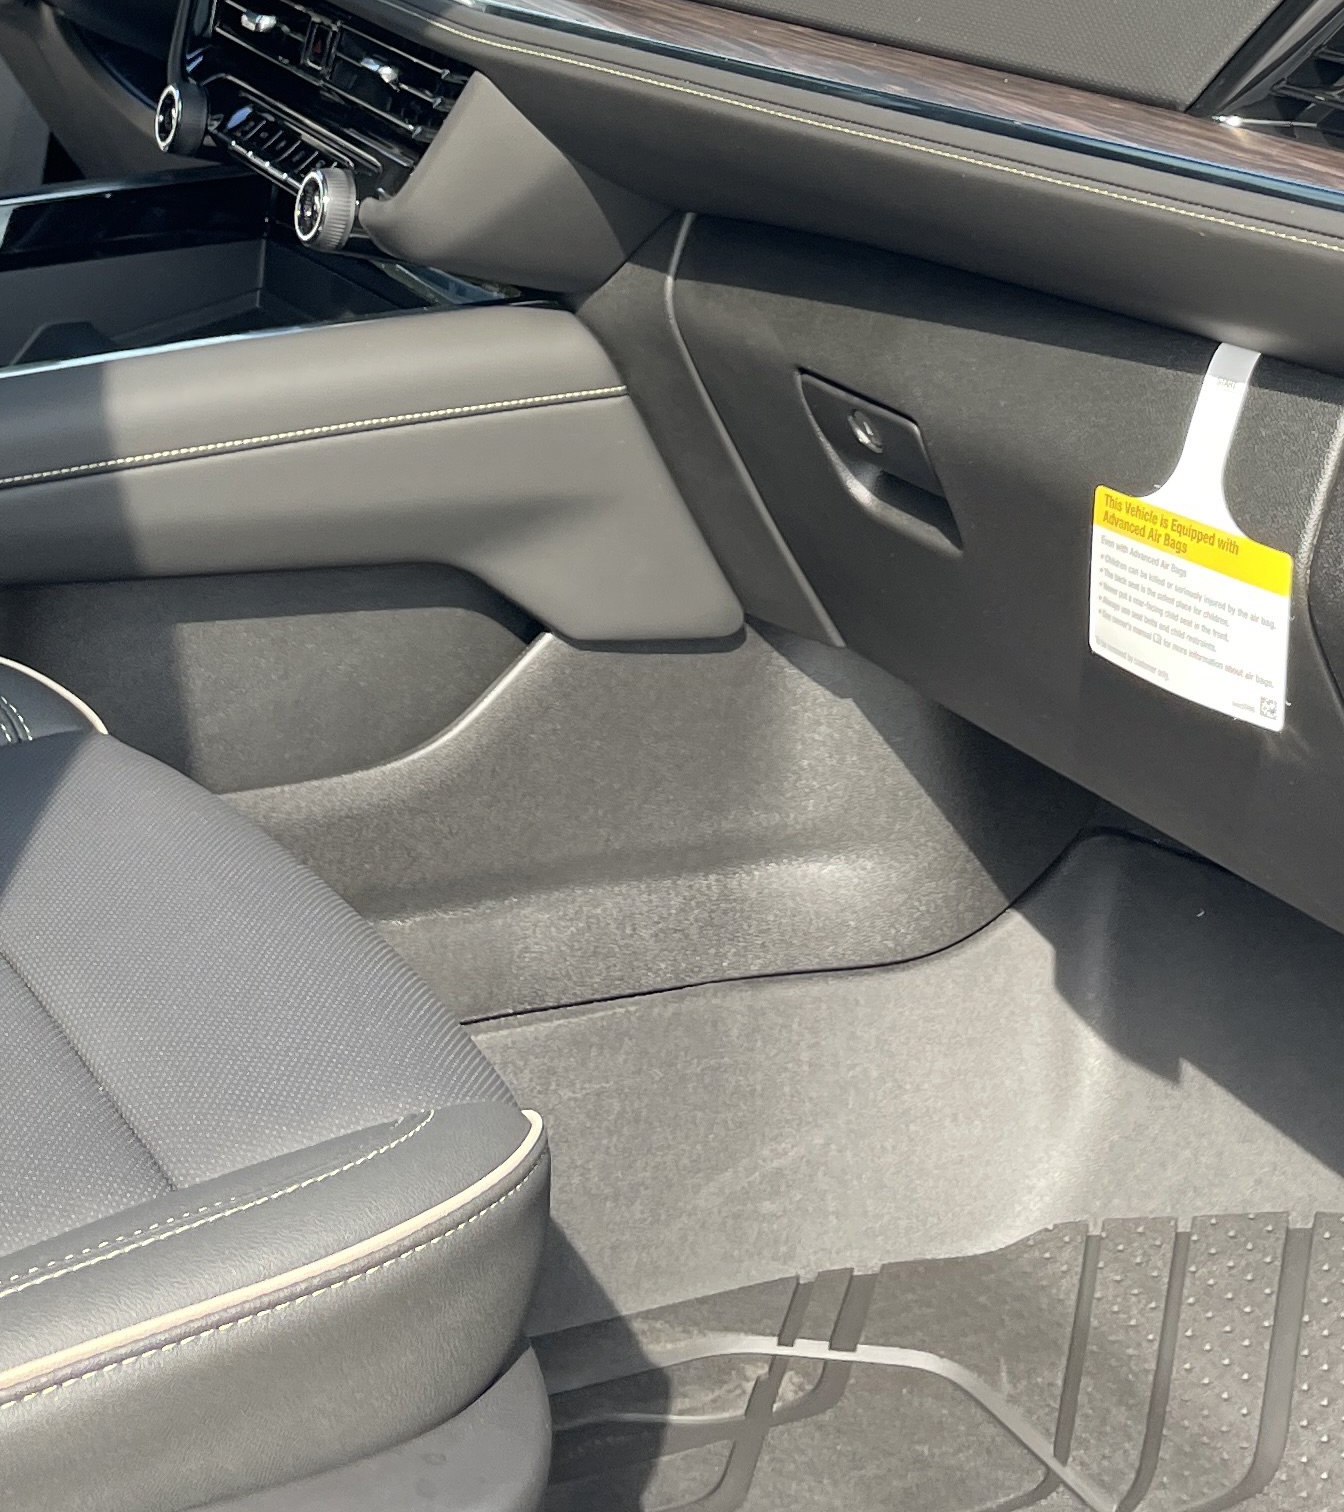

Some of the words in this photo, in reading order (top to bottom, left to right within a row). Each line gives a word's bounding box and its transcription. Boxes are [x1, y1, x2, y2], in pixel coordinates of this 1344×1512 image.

[1102, 509, 1145, 538] Advanced
[1147, 526, 1160, 544] Air
[1163, 532, 1187, 556] Bags
[1105, 492, 1122, 513] This
[1125, 500, 1158, 526] Vehicle
[1160, 514, 1168, 530] is
[1170, 518, 1215, 549] Equipped
[1217, 535, 1239, 556] with
[1100, 534, 1114, 548] Even
[1116, 541, 1128, 553] with
[1129, 547, 1159, 567] Advanced
[1160, 559, 1169, 570] Air
[1170, 563, 1186, 579] Bags
[1104, 553, 1127, 571] Children
[1227, 603, 1235, 616] by
[1237, 607, 1247, 619] the
[1250, 612, 1258, 623] air
